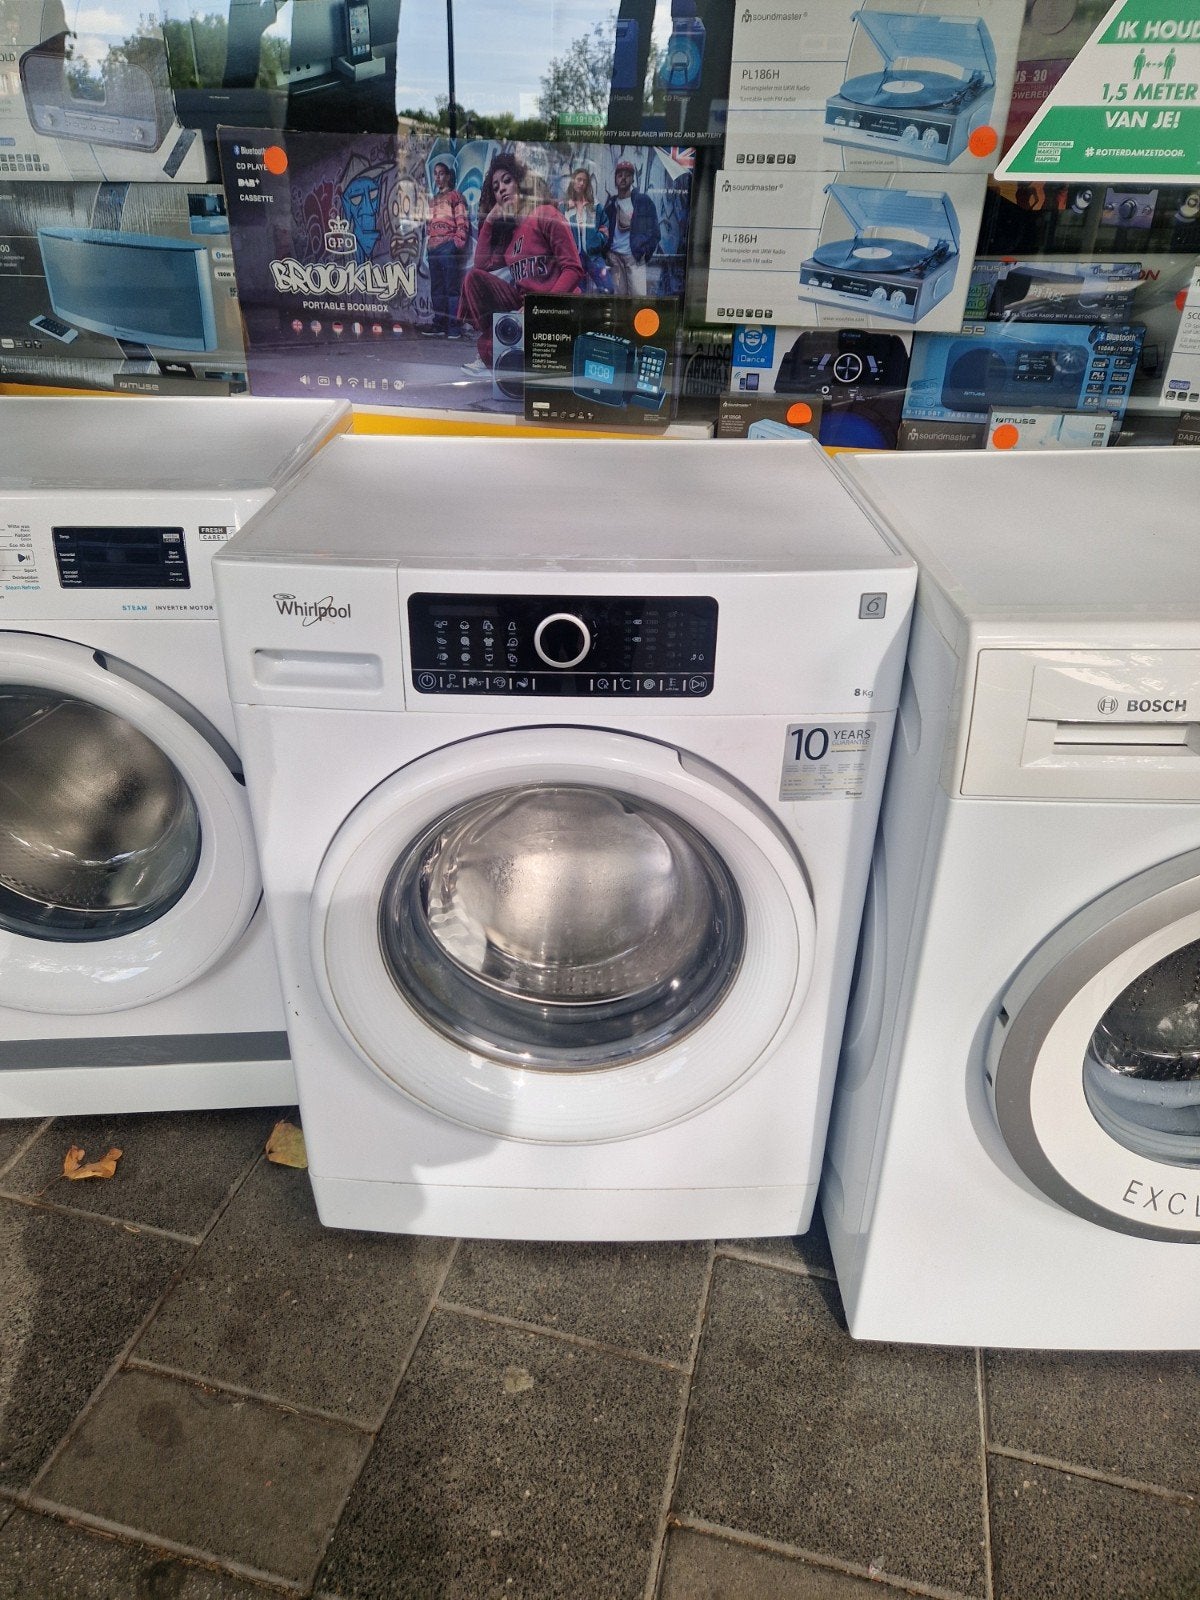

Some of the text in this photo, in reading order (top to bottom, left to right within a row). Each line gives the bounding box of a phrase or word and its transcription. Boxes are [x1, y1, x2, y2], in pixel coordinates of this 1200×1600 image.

[753, 12, 802, 22] soundmaster
[1116, 20, 1139, 39] IK
[742, 69, 780, 80] PL186H
[1102, 83, 1198, 103] 1,5 METER
[1104, 111, 1181, 129] VAN JE!
[565, 130, 600, 138] BLUETOOTH
[697, 132, 722, 140] BATTERY
[1085, 146, 1186, 158] #ROTTERDAMZETDOOR.
[236, 162, 246, 170] CD
[732, 183, 778, 192] soundmaster
[239, 194, 274, 203] CASSETTE
[328, 236, 353, 250] GPO
[722, 233, 758, 244] PL186H
[269, 257, 418, 300] BROOKLYN
[302, 301, 389, 312] PORTABLE BOOMBOX
[1106, 333, 1136, 342] Bluetooth
[128, 382, 160, 391] muse
[1004, 417, 1037, 425] muse
[919, 432, 971, 442] soundmaster
[121, 604, 214, 612] STEAM INVERTER MOTOR
[866, 596, 881, 612] 6
[274, 599, 352, 622] Whirlpool
[854, 687, 874, 698] 8 Kg
[1126, 699, 1187, 712] BOSCH
[791, 727, 871, 760] 10 YEARS
